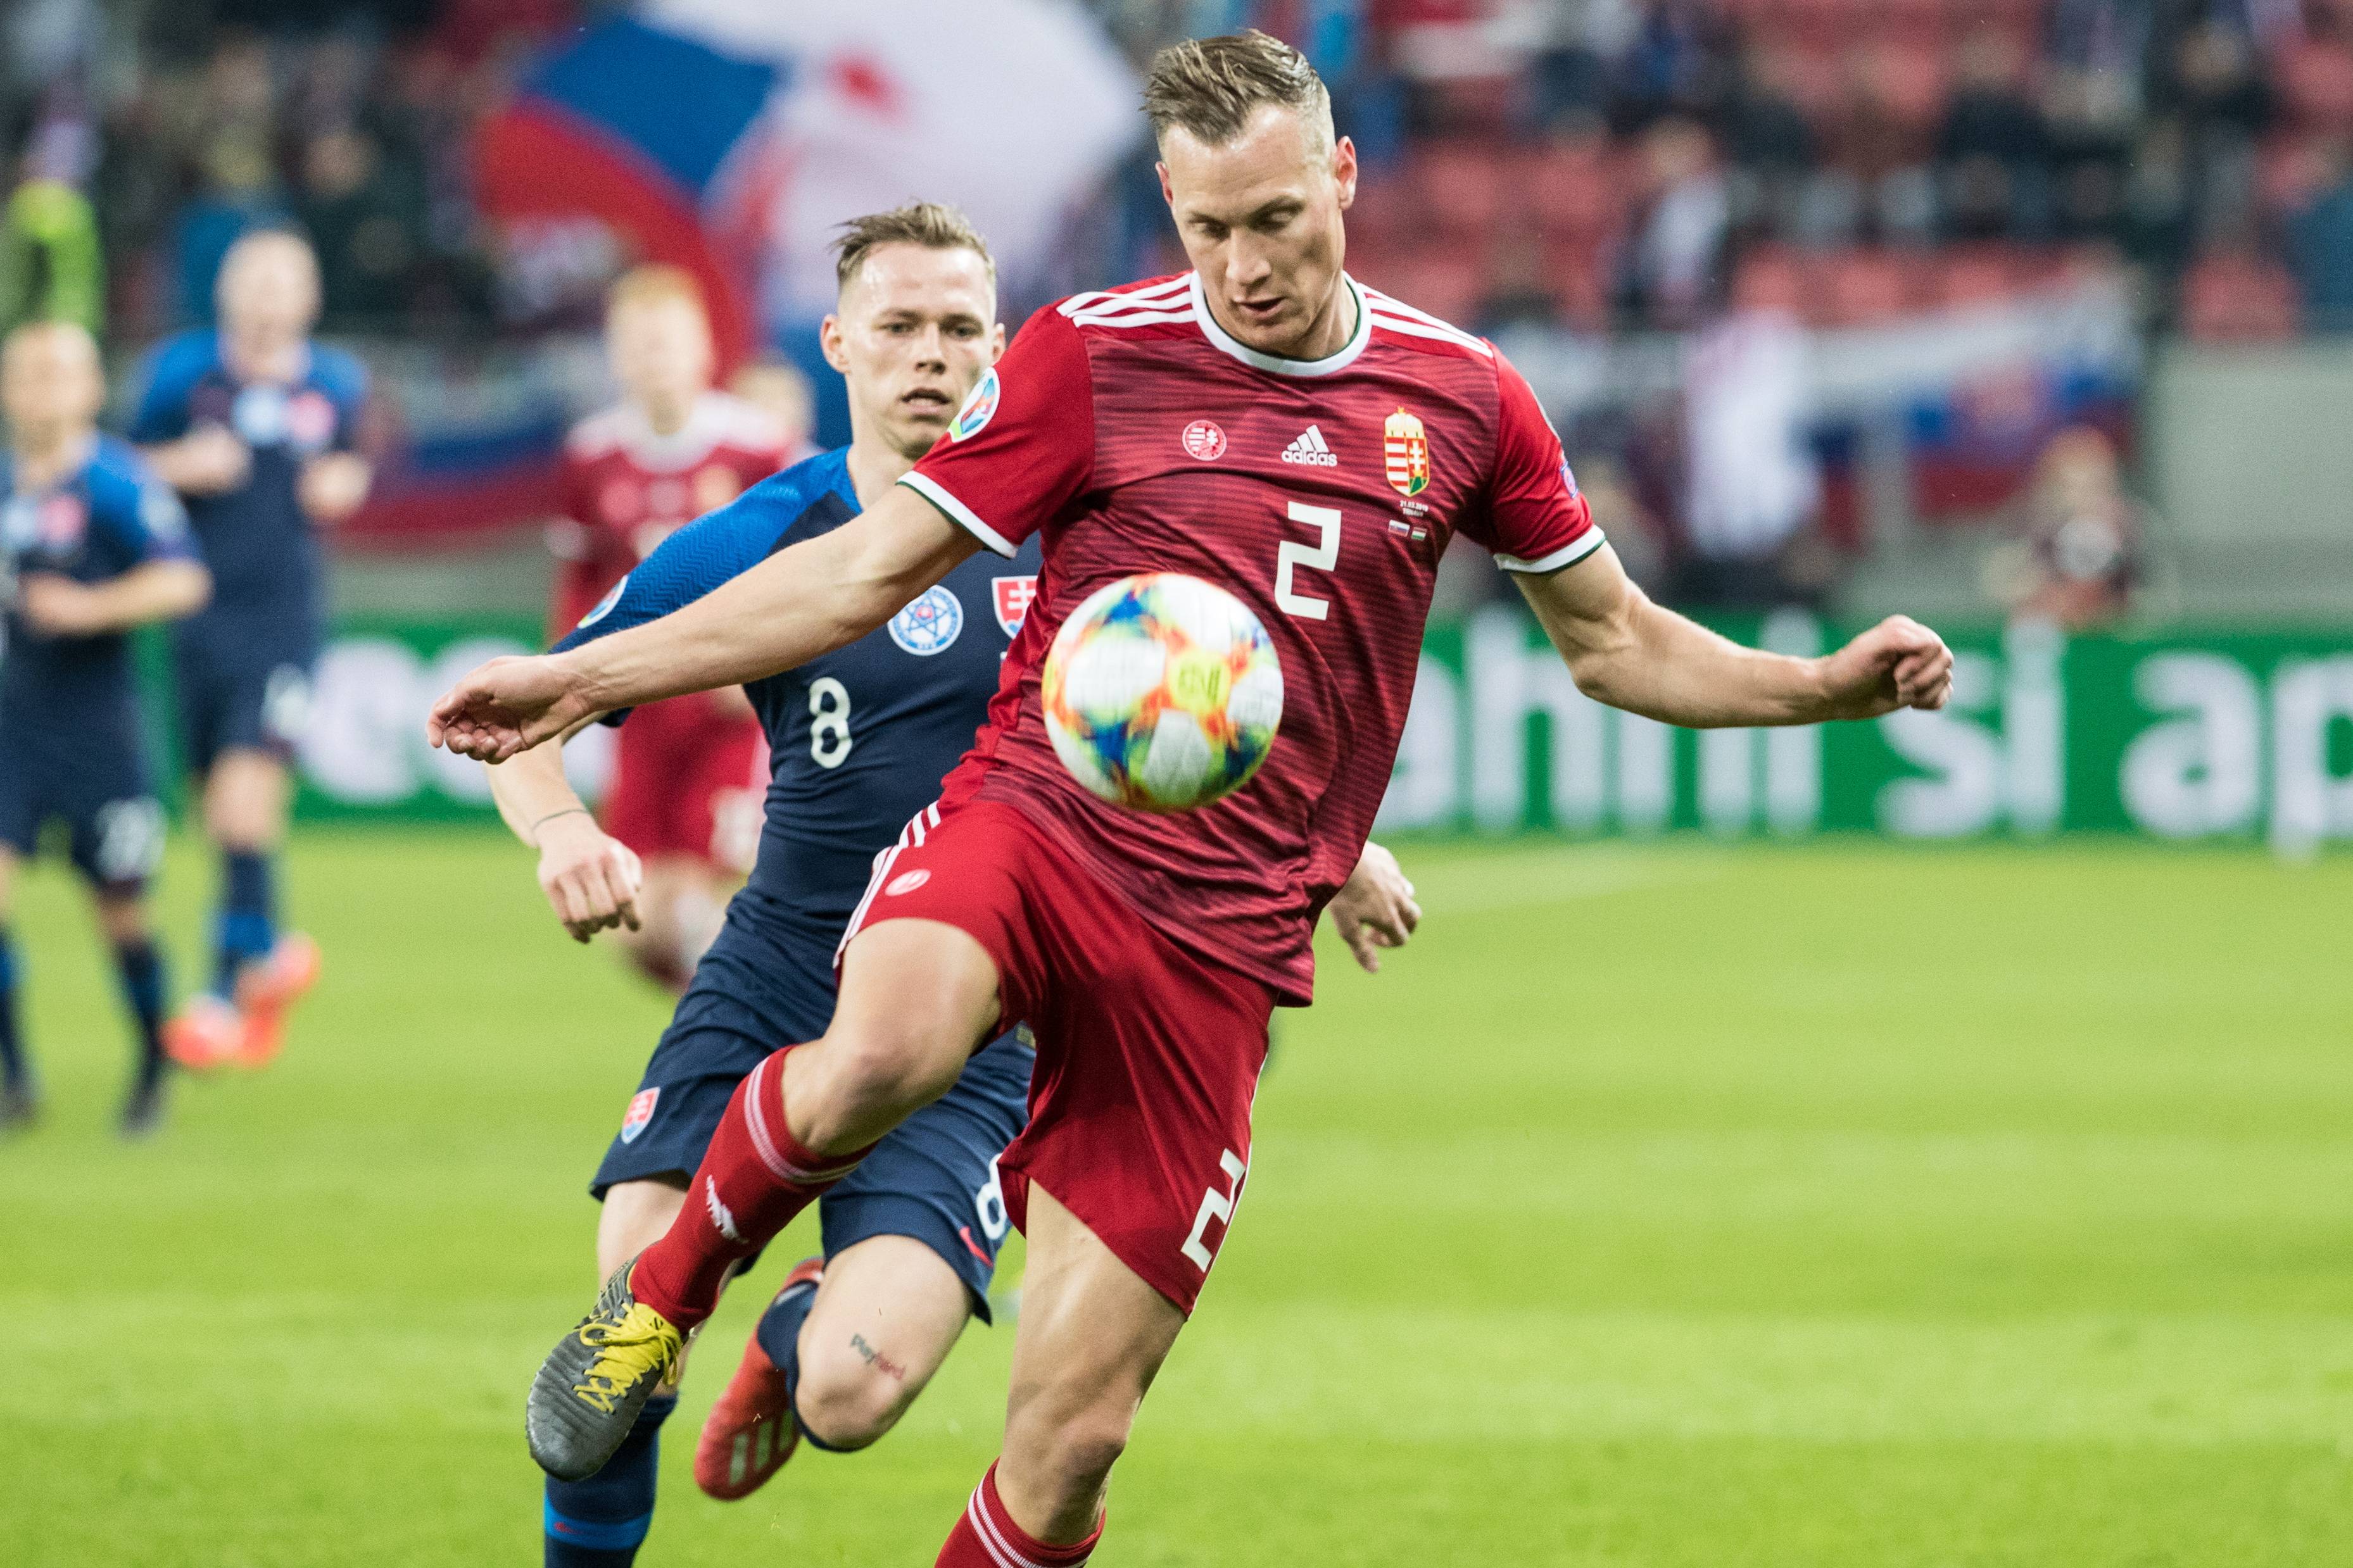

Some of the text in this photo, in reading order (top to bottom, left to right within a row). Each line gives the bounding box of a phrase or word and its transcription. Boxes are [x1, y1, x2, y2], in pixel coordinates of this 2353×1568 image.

[1281, 450, 1338, 467] adidas
[1275, 501, 1342, 620] 2
[809, 677, 853, 769] 8
[1874, 615, 2066, 834] si
[1180, 1148, 1246, 1273] 2
